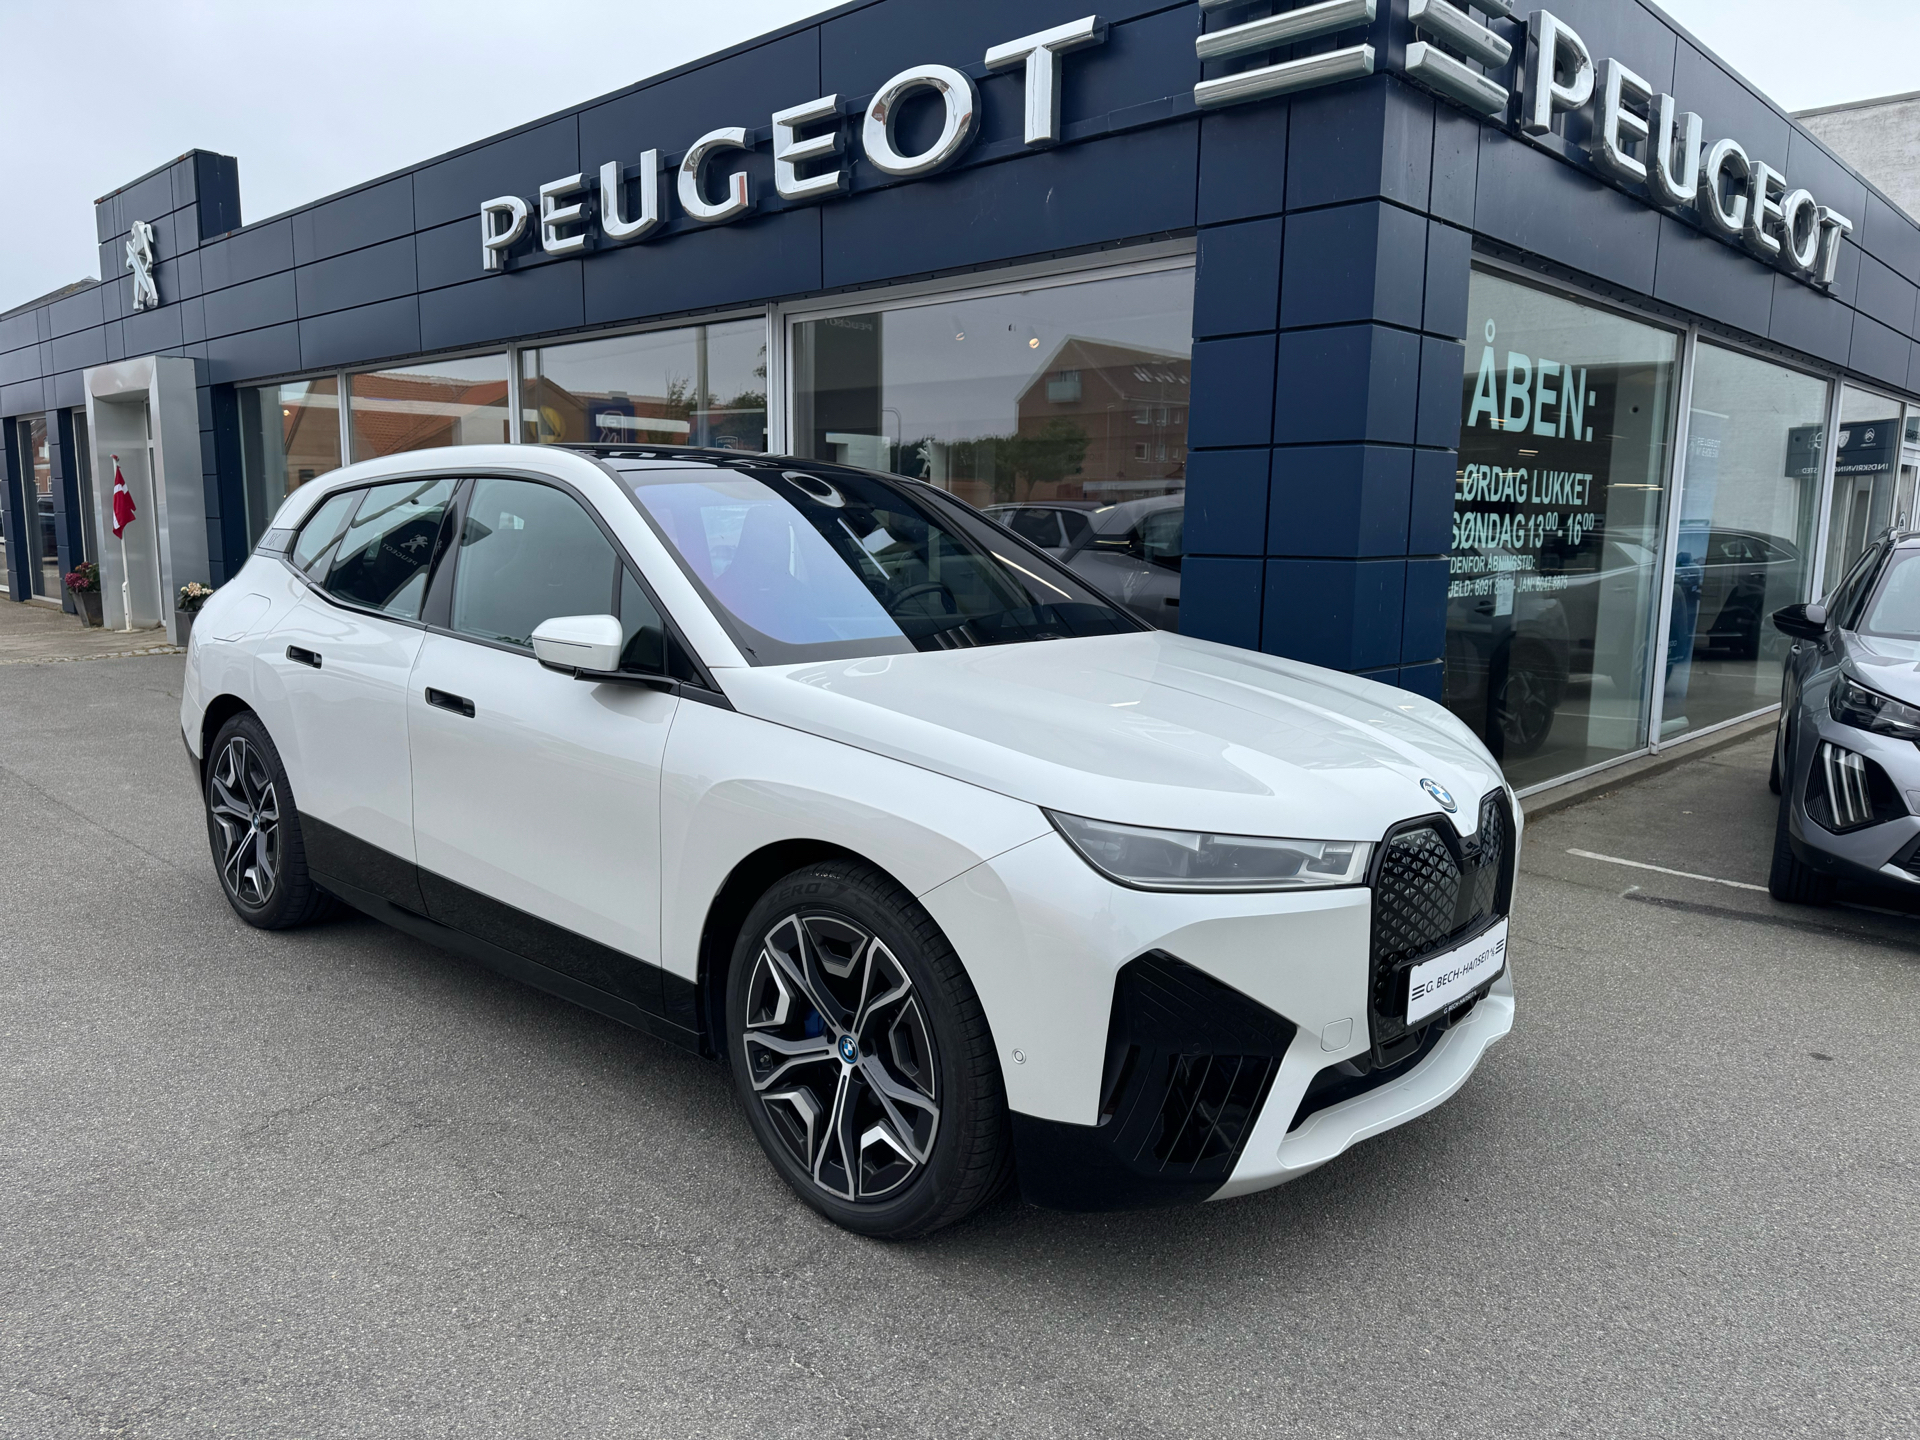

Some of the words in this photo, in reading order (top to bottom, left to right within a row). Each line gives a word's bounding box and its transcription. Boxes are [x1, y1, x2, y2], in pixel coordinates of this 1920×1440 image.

[481, 14, 1104, 272] PEUGEOT
[1522, 9, 1853, 285] PEUGEOT
[1466, 318, 1597, 442] ÅBEN:
[1531, 469, 1593, 506] LUKKET
[1451, 511, 1526, 550] SØNDAG
[1450, 556, 1485, 574] DENFOR
[1448, 579, 1473, 598] JELD:
[1475, 579, 1492, 596] 6091
[1517, 576, 1535, 593] JAN:
